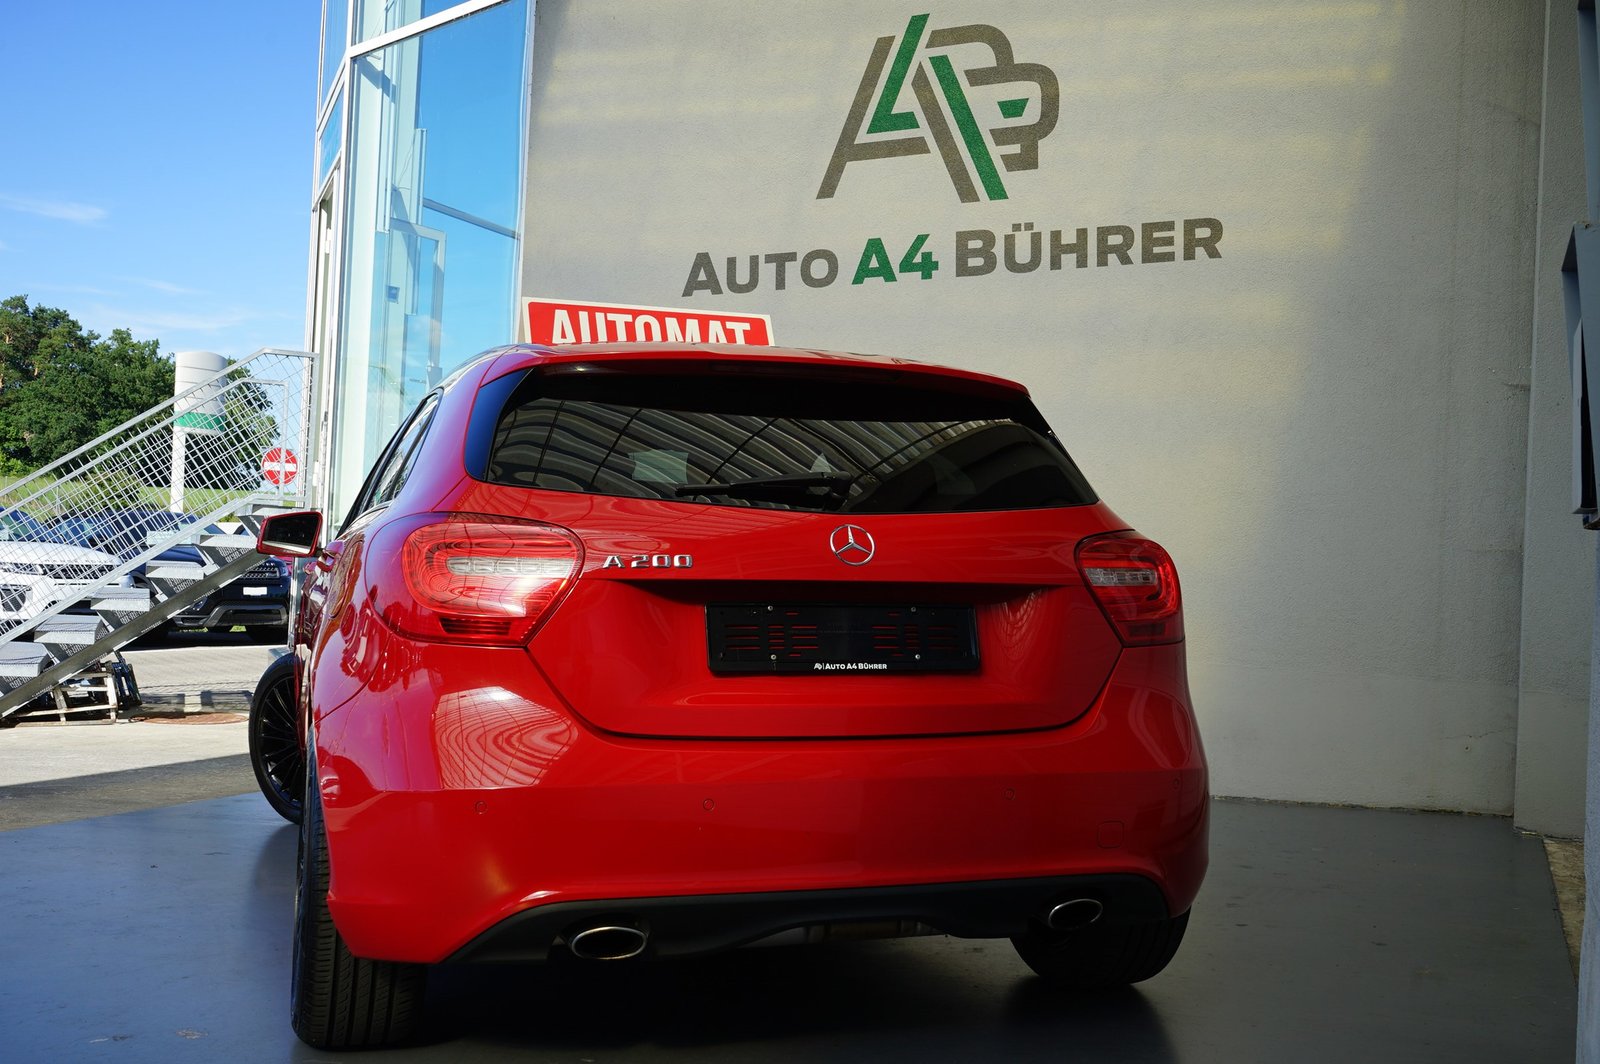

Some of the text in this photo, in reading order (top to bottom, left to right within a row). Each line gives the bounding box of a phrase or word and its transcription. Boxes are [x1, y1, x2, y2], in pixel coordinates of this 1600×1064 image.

[681, 217, 1224, 298] AUTO A4 BÜHRER
[551, 309, 751, 345] AUTOMAT
[602, 554, 693, 568] A 200
[825, 662, 846, 670] AUTO
[846, 662, 857, 670] A4
[858, 662, 888, 670] BÜHRER
